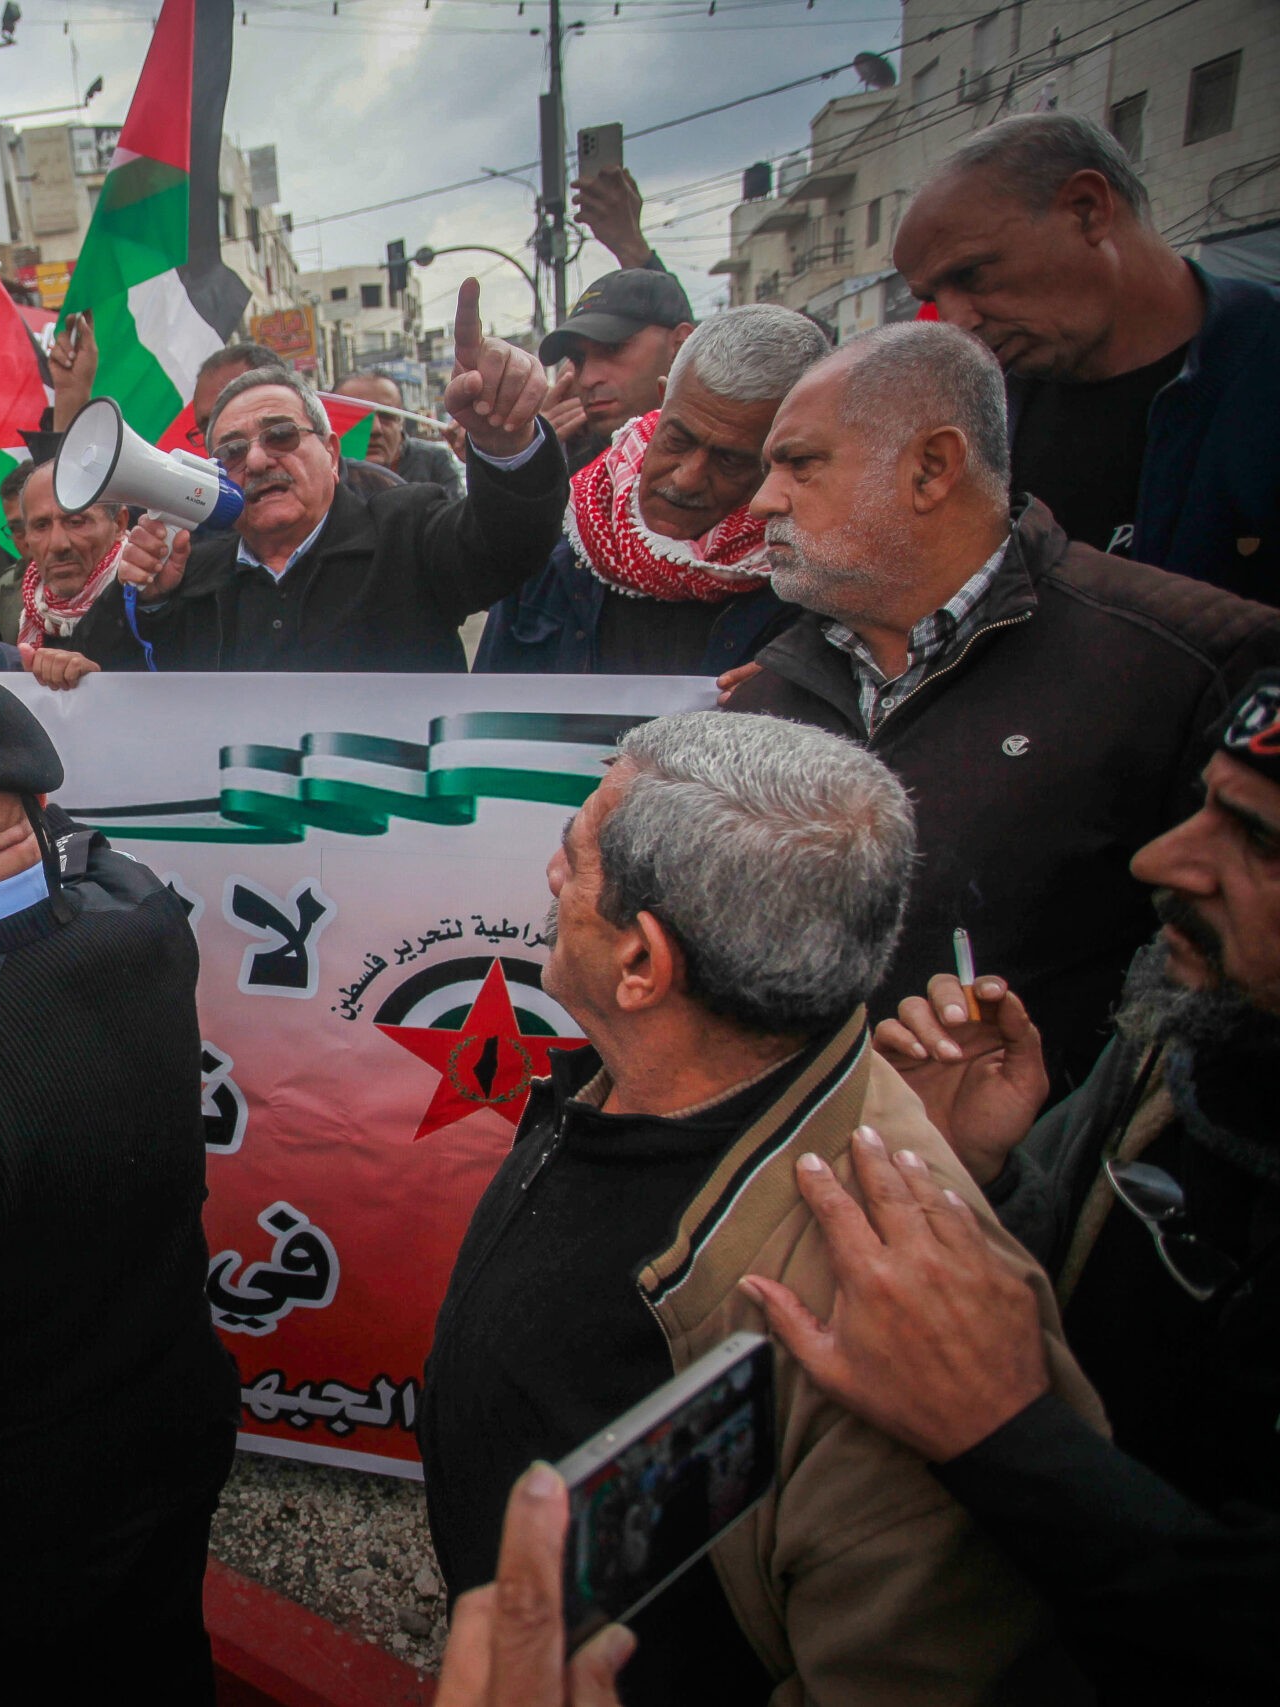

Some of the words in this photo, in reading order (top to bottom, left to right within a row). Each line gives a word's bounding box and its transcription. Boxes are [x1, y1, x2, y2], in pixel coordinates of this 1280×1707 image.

[232, 884, 327, 989] لا
[393, 918, 464, 965] لتحرير
[331, 952, 388, 1021] فلسطين
[206, 1209, 331, 1328] في
[240, 1372, 416, 1433] الجبه
